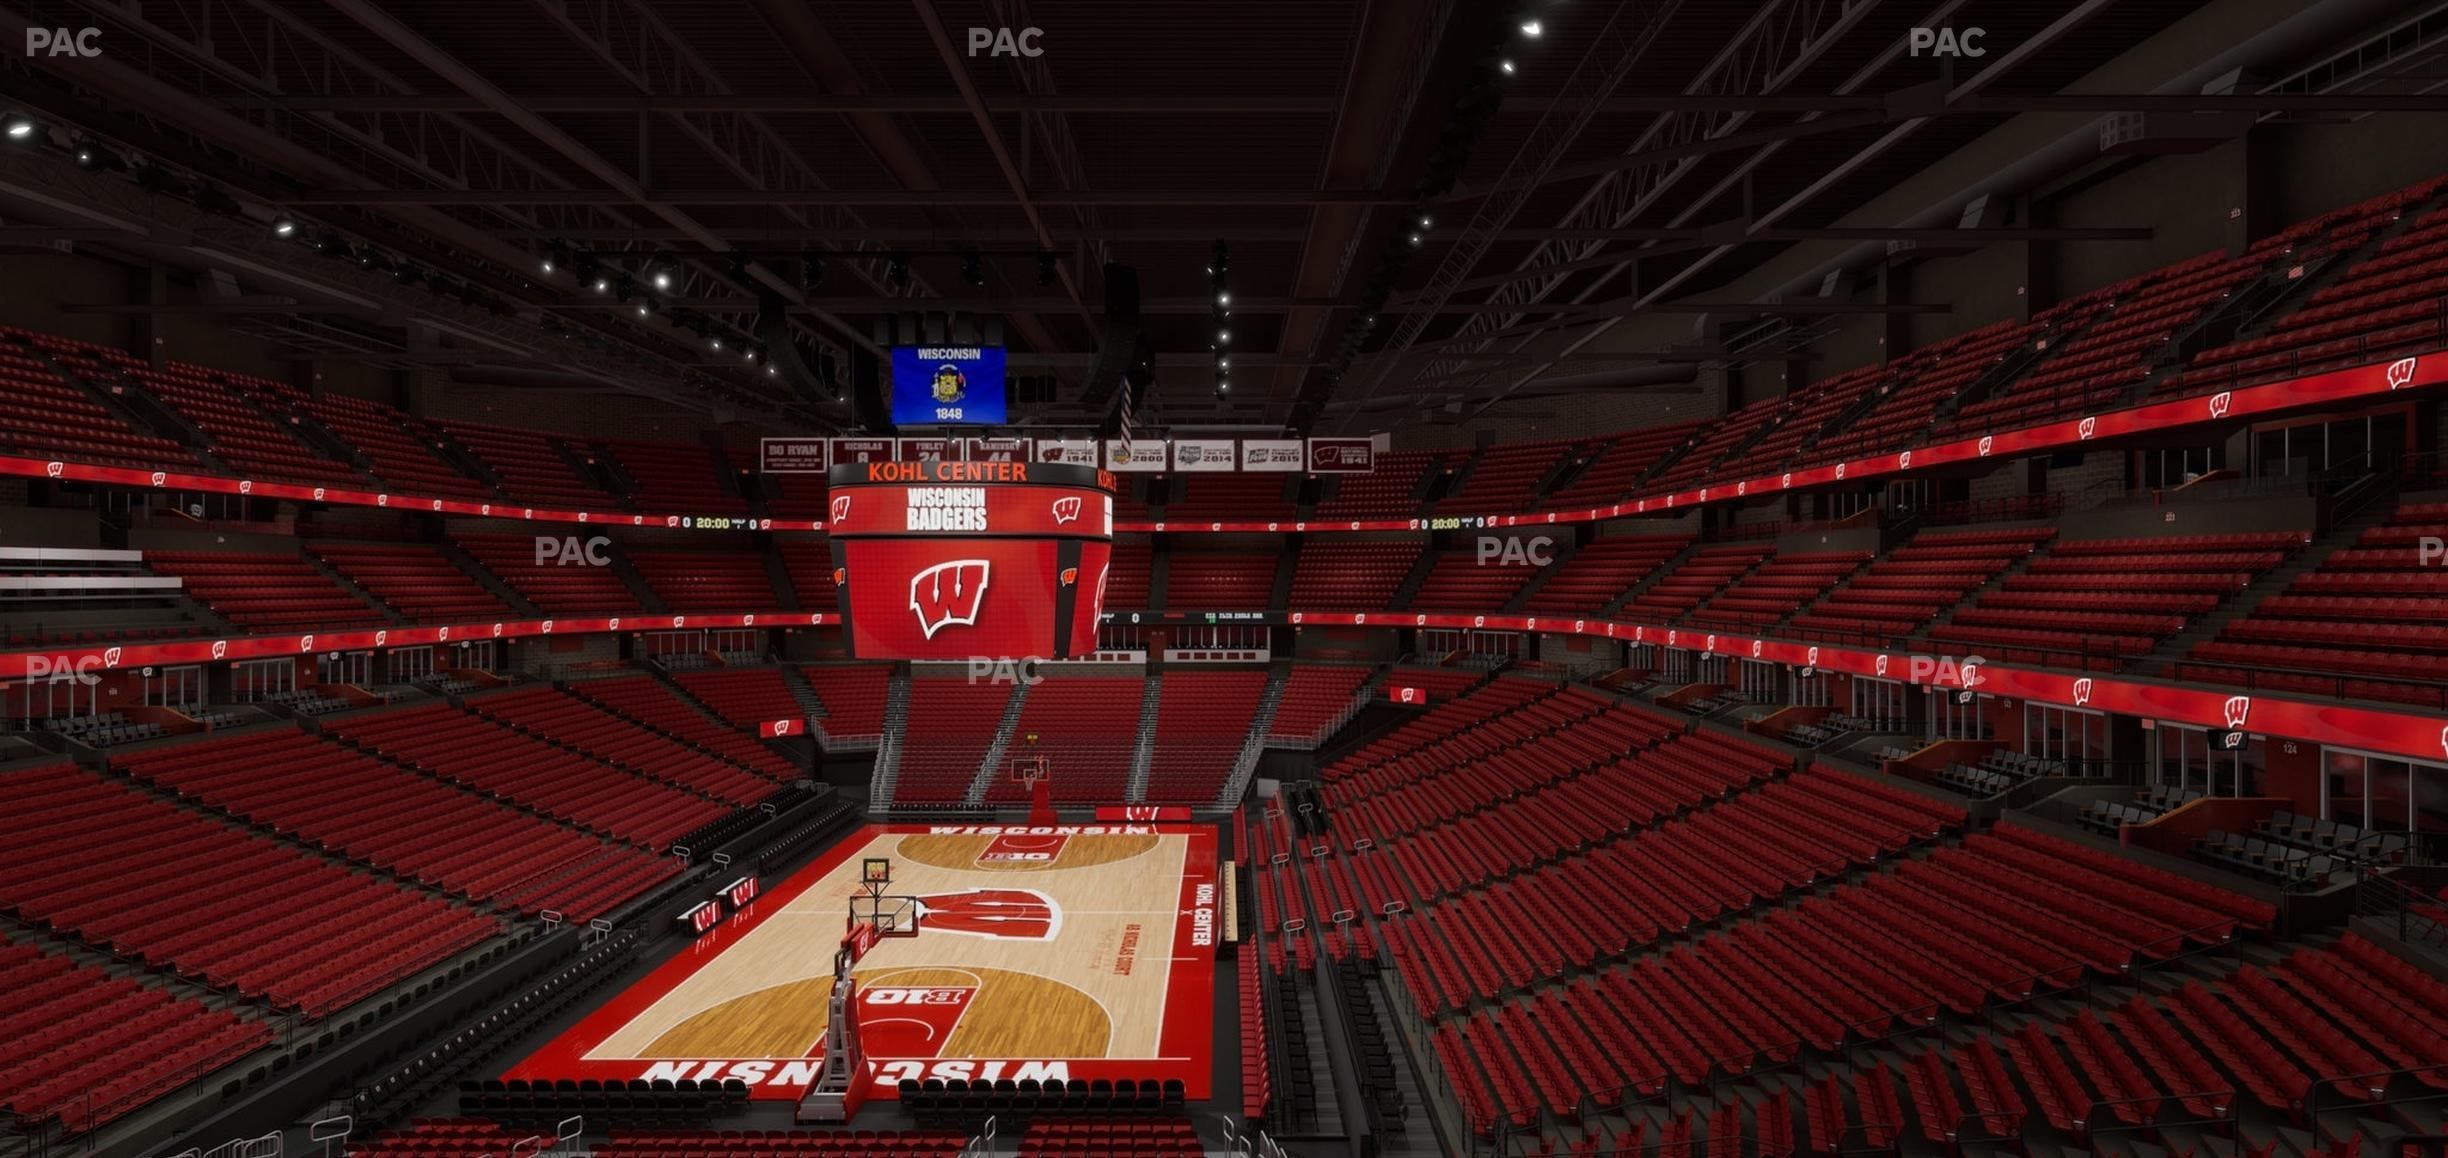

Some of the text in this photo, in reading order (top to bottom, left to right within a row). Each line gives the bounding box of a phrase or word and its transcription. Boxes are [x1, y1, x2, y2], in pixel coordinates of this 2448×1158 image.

[918, 348, 980, 360] WISCONSIN
[936, 408, 963, 420] 1848
[768, 445, 818, 456] BO RYAN
[869, 462, 1027, 482] KOHL CENTER
[907, 488, 986, 508] WISCONSIN
[682, 516, 757, 530] 0 20:00 0
[907, 507, 988, 531] BADGERS
[1421, 516, 1484, 530] 0 20:00 0
[1131, 612, 1140, 624] 0
[2283, 743, 2297, 754] 124
[929, 826, 1150, 836] WISCONSIN
[1192, 884, 1214, 946] KOHL CENTER
[639, 1061, 1070, 1088] WISCNSIN
